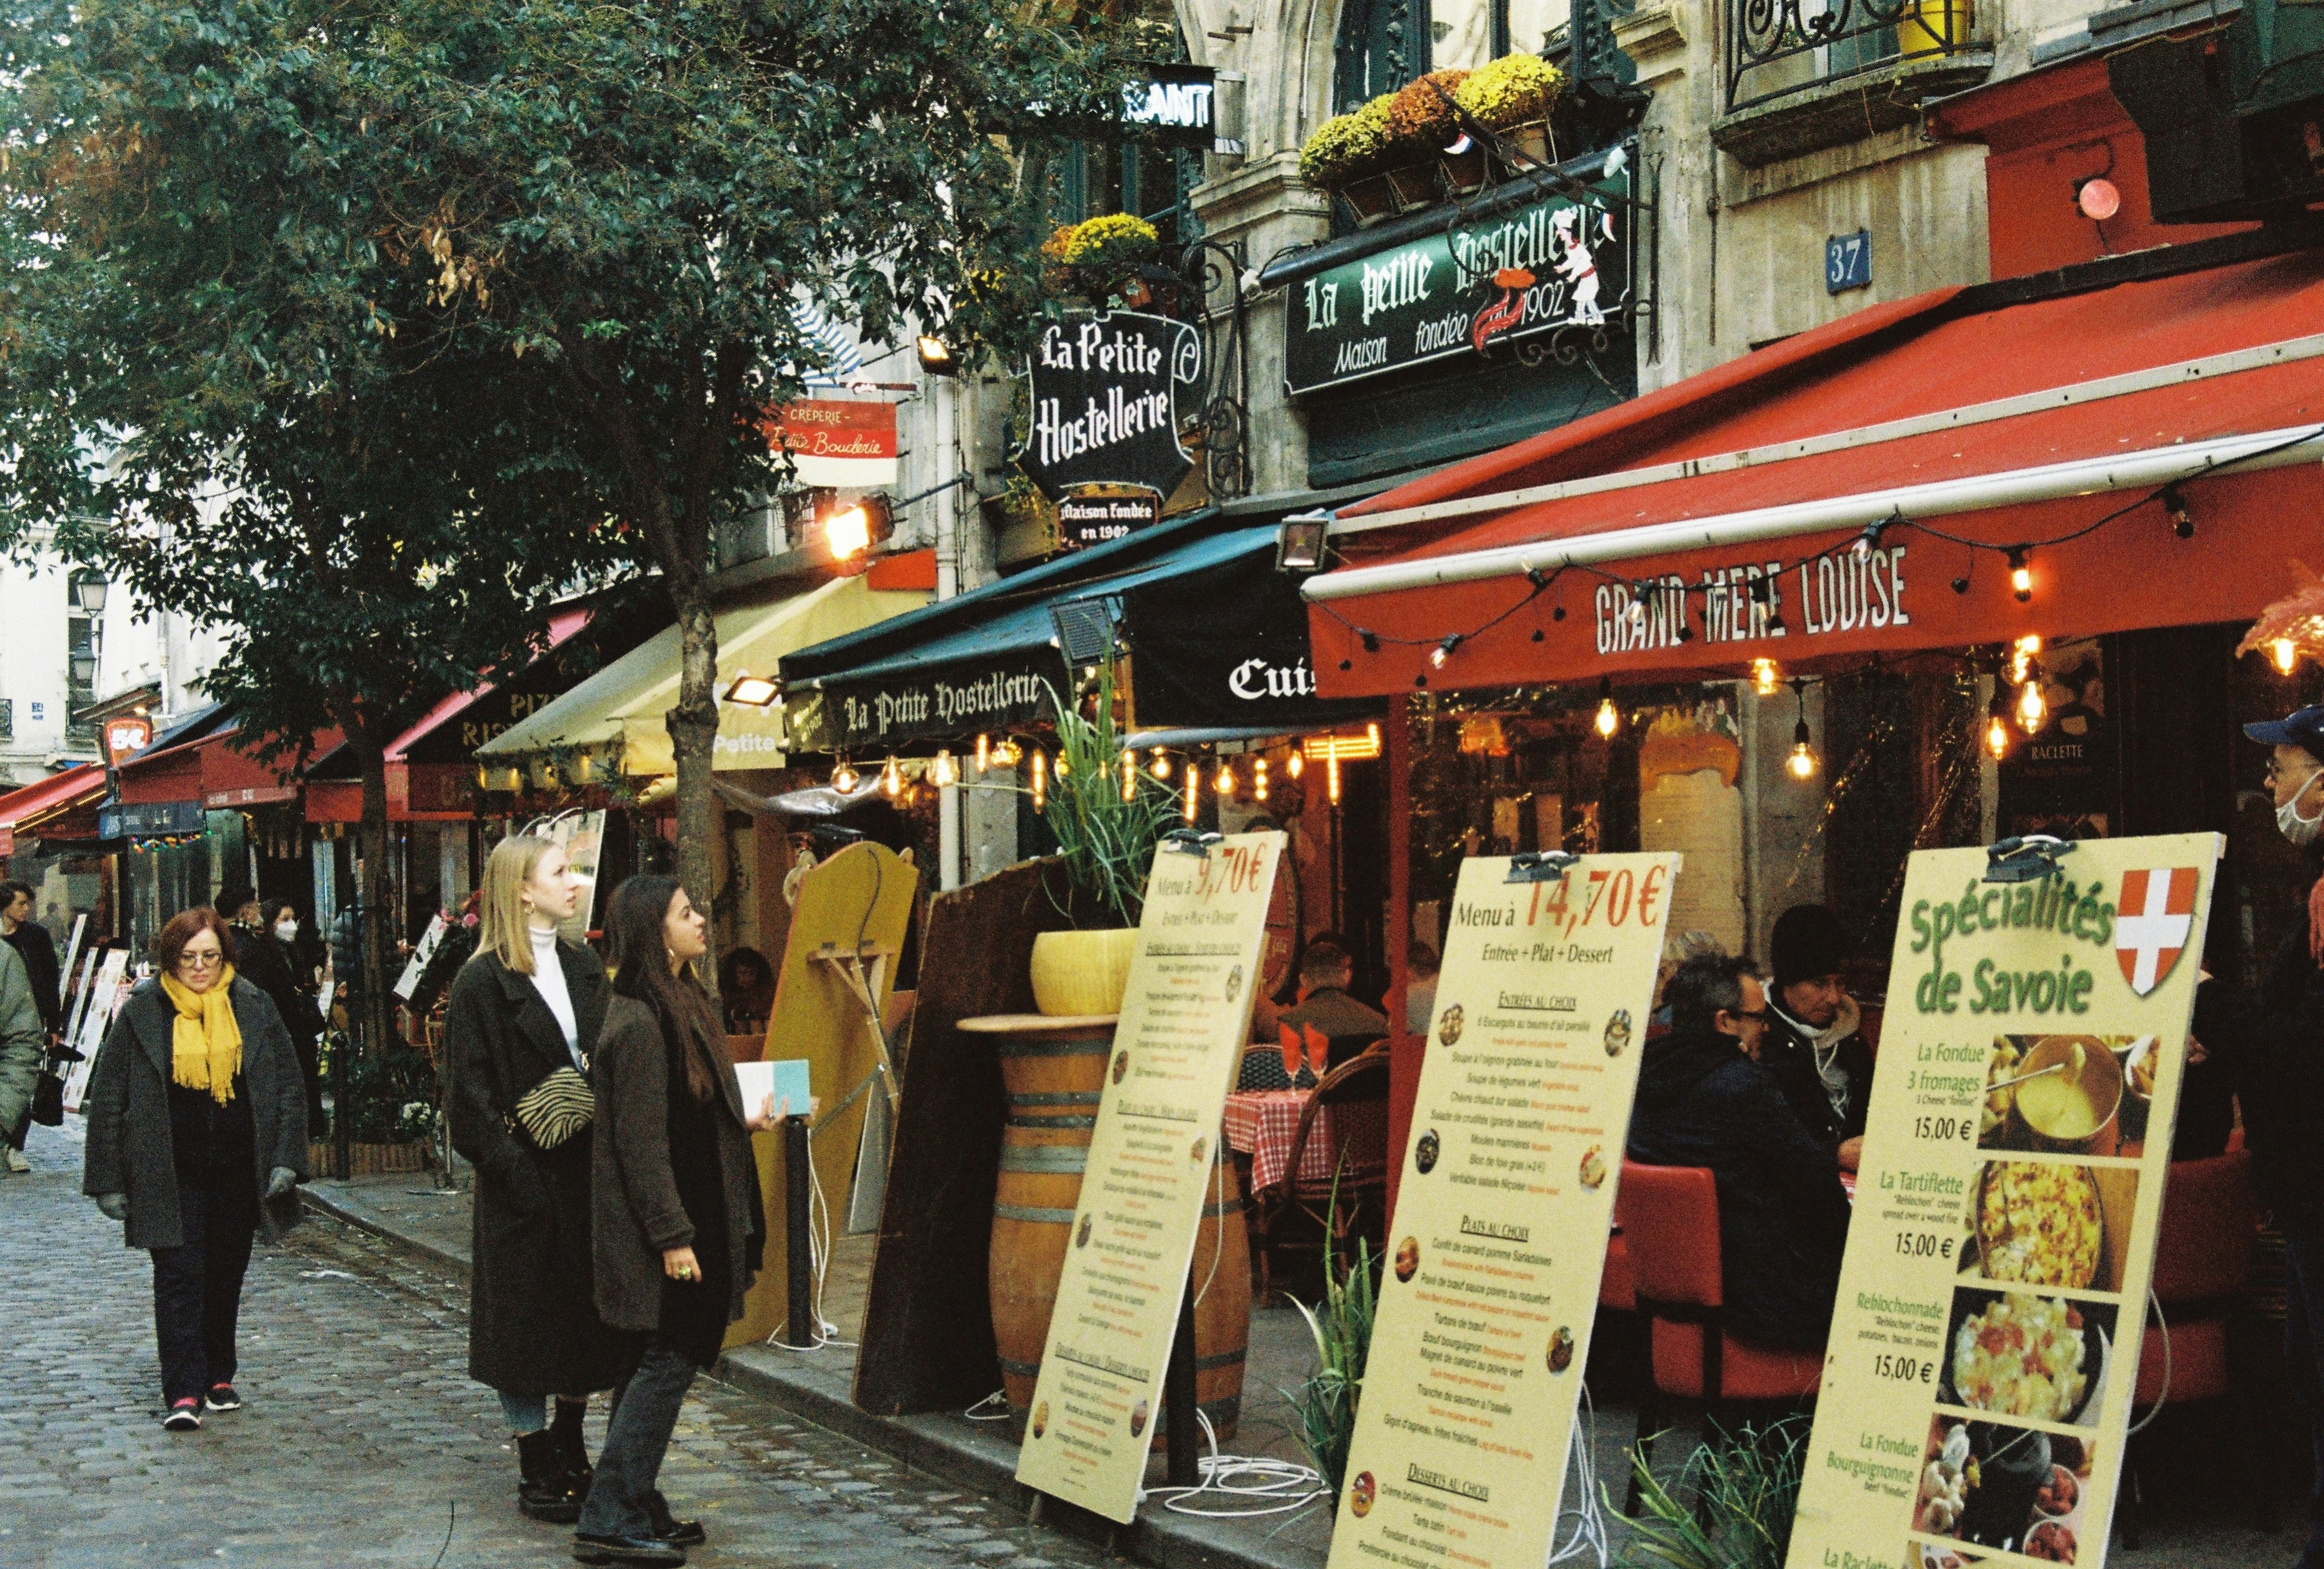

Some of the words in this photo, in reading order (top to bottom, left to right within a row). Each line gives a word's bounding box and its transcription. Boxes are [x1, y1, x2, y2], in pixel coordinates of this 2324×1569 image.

[1831, 239, 1862, 284] 37
[1304, 277, 1338, 333] La
[1333, 335, 1387, 375] Maison
[1416, 311, 1468, 355] fondée
[1521, 279, 1565, 326] 1902
[1039, 324, 1075, 370] La
[1076, 321, 1162, 375] Petite
[1036, 385, 1169, 467] Hostellerie
[1060, 502, 1109, 520] Maison
[1080, 527, 1097, 540] en
[1098, 524, 1130, 540] 1902
[1594, 573, 1686, 655] GRAND
[1800, 546, 1911, 636] LOUISE
[844, 695, 869, 733] La
[711, 733, 775, 754] Petite
[2031, 744, 2083, 760] RACLETTE
[1455, 902, 1502, 927] Menu
[1504, 901, 1515, 927] à
[1482, 942, 1518, 962] Entrée
[1531, 943, 1555, 963] Plat
[1566, 943, 1614, 963] Dessert
[1914, 967, 1962, 1015] de
[1968, 954, 2094, 1015] Savoie
[1917, 1043, 1932, 1062] La
[1935, 1042, 1985, 1063] Fondue
[1907, 1070, 1916, 1090] 3
[1919, 1069, 1980, 1097] fromages
[1914, 1116, 1956, 1141] 15,00
[1959, 1119, 1973, 1141] €
[1880, 1170, 1894, 1189] La
[1900, 1171, 1963, 1194] Tartiflette
[1896, 1232, 1936, 1258] 15,00
[1940, 1238, 1954, 1259] €
[1874, 1354, 1916, 1381] 15,00
[1919, 1362, 1934, 1384] €
[1859, 1431, 1874, 1450] La
[1876, 1434, 1920, 1459] Fondue
[1826, 1450, 1914, 1484] Bourguignonne
[1823, 1548, 1839, 1568] La
